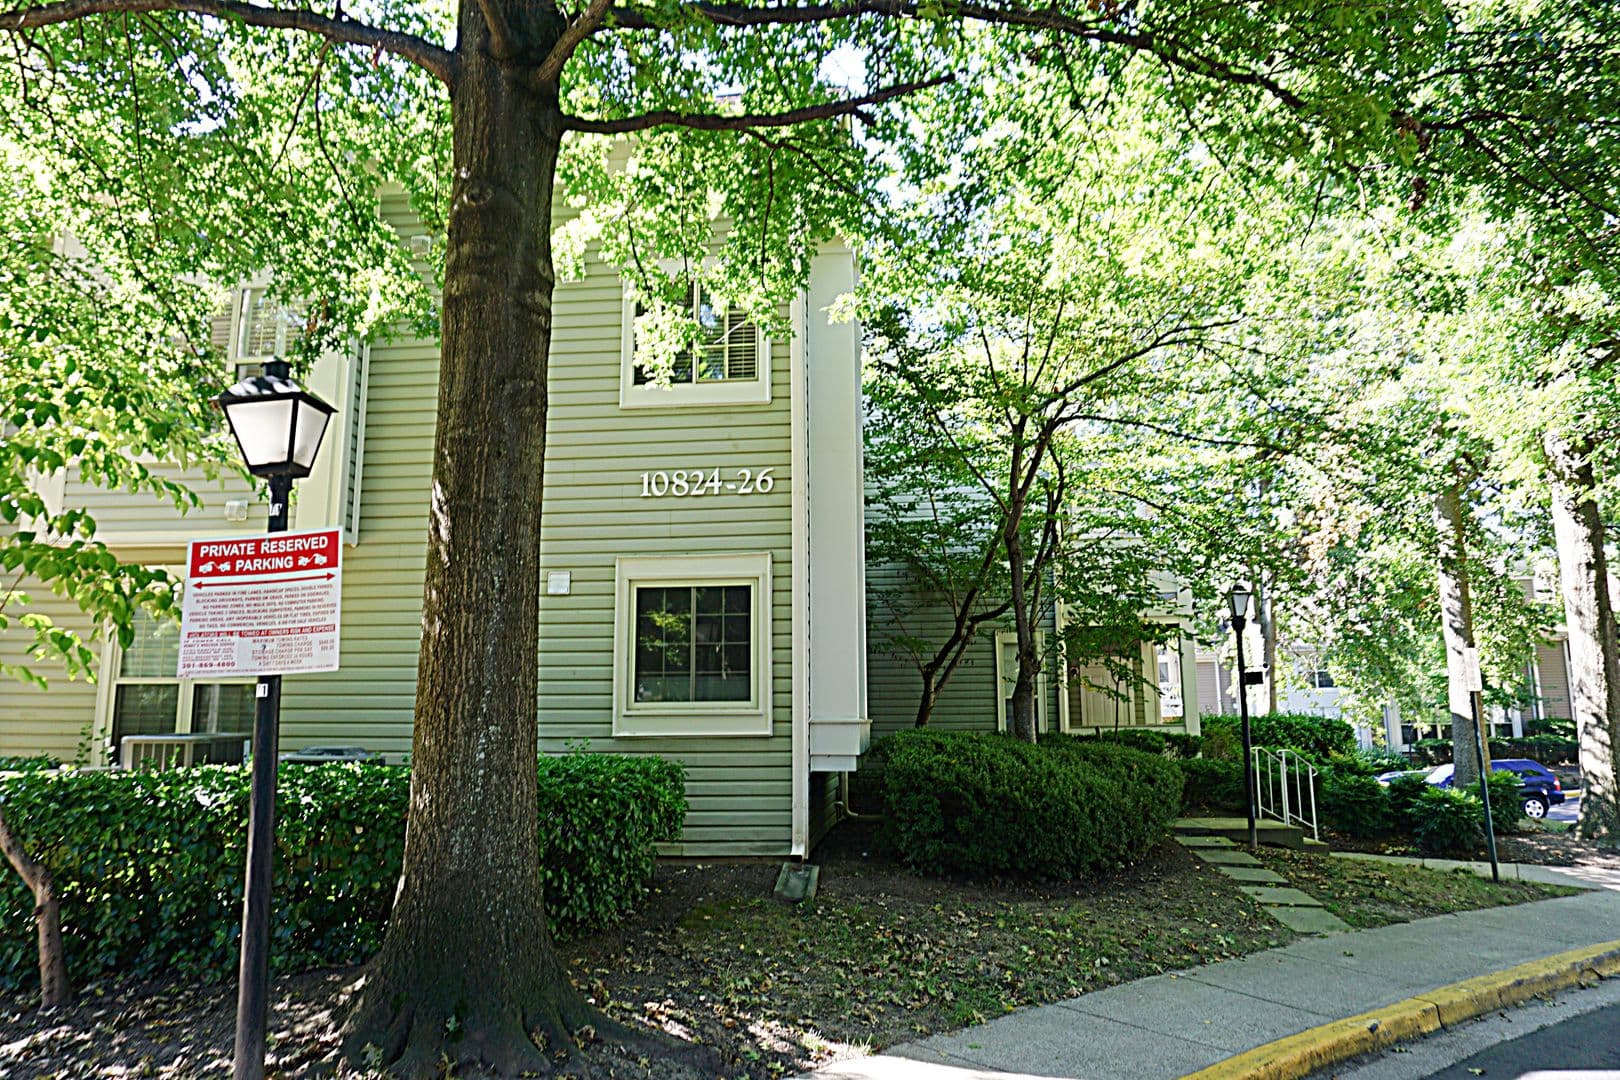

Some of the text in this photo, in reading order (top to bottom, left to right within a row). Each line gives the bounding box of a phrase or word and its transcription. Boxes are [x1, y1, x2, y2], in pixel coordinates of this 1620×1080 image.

[640, 467, 775, 497] 10824-26
[200, 536, 328, 558] PRIVATE RESERVED
[236, 556, 294, 572] PARKING
